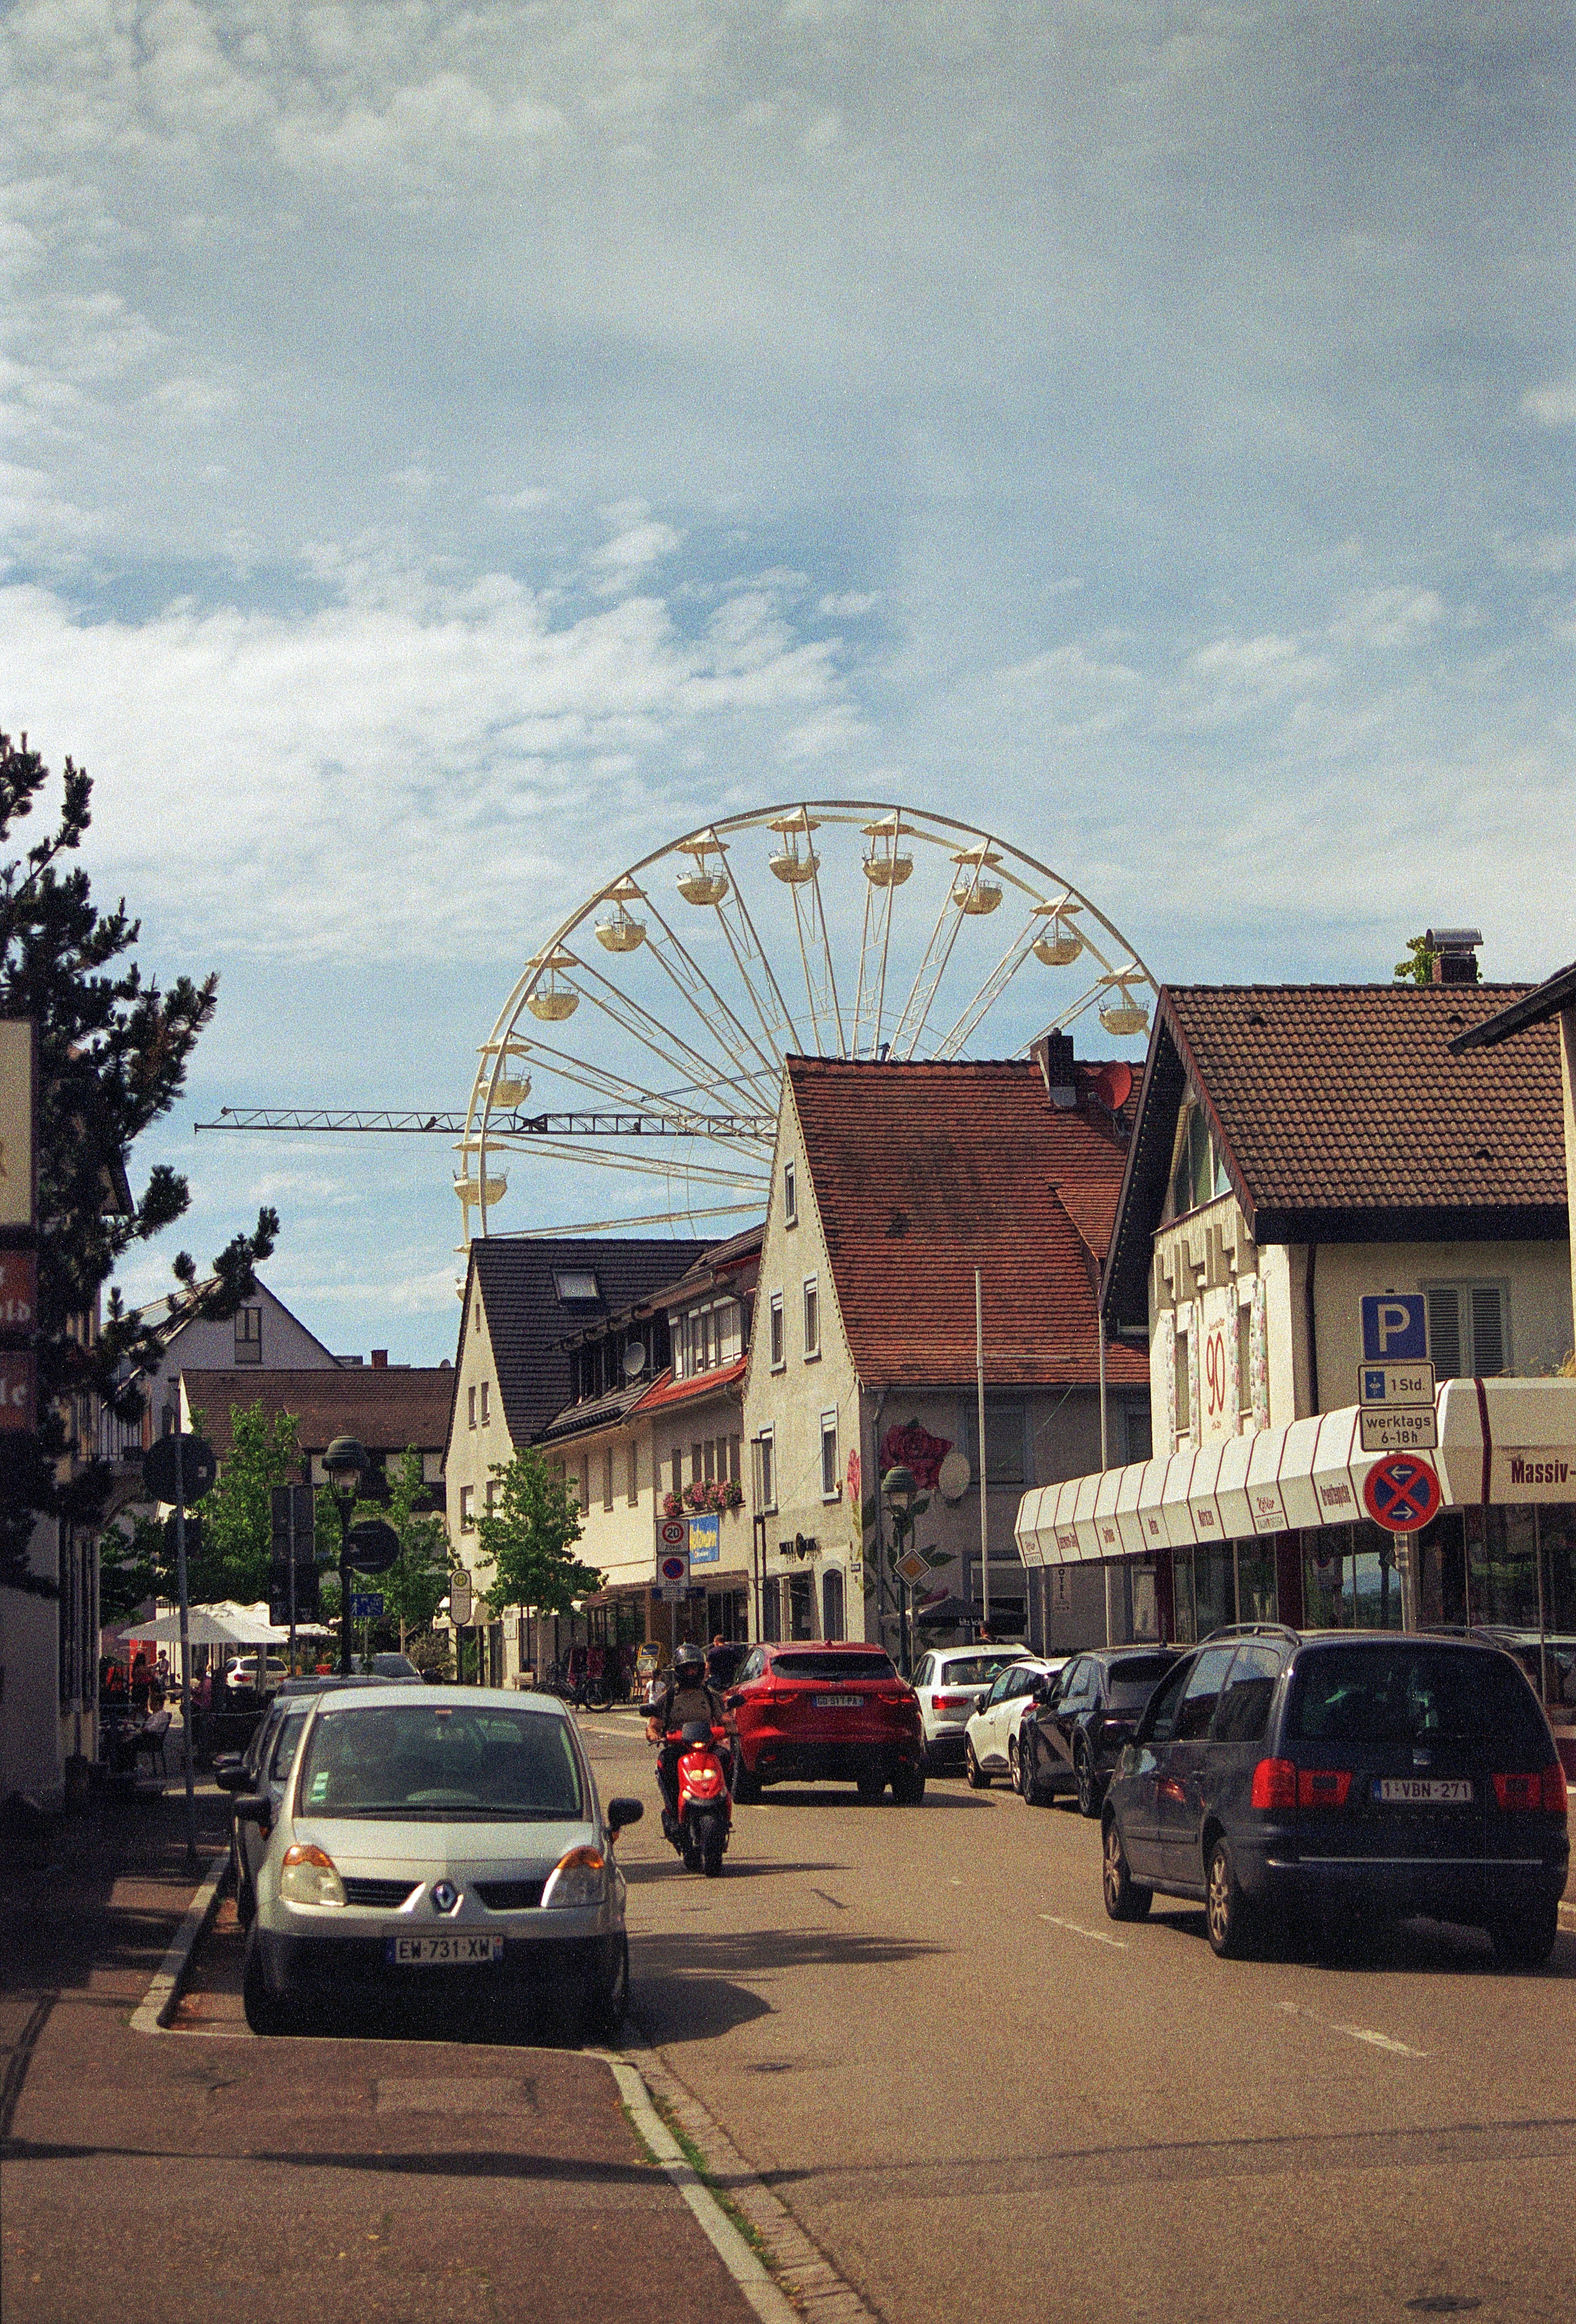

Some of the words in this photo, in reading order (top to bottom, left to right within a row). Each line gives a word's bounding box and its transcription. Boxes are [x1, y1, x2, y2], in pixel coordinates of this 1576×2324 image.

[1378, 1303, 1410, 1352] P
[1206, 1331, 1225, 1416] 90
[1392, 1379, 1396, 1391] 1
[1400, 1378, 1425, 1391] Std.
[1366, 1415, 1431, 1429] werktags
[1511, 1459, 1576, 1483] Massiv-
[667, 1527, 679, 1538] 20
[400, 1939, 489, 1959] EW-731-XW
